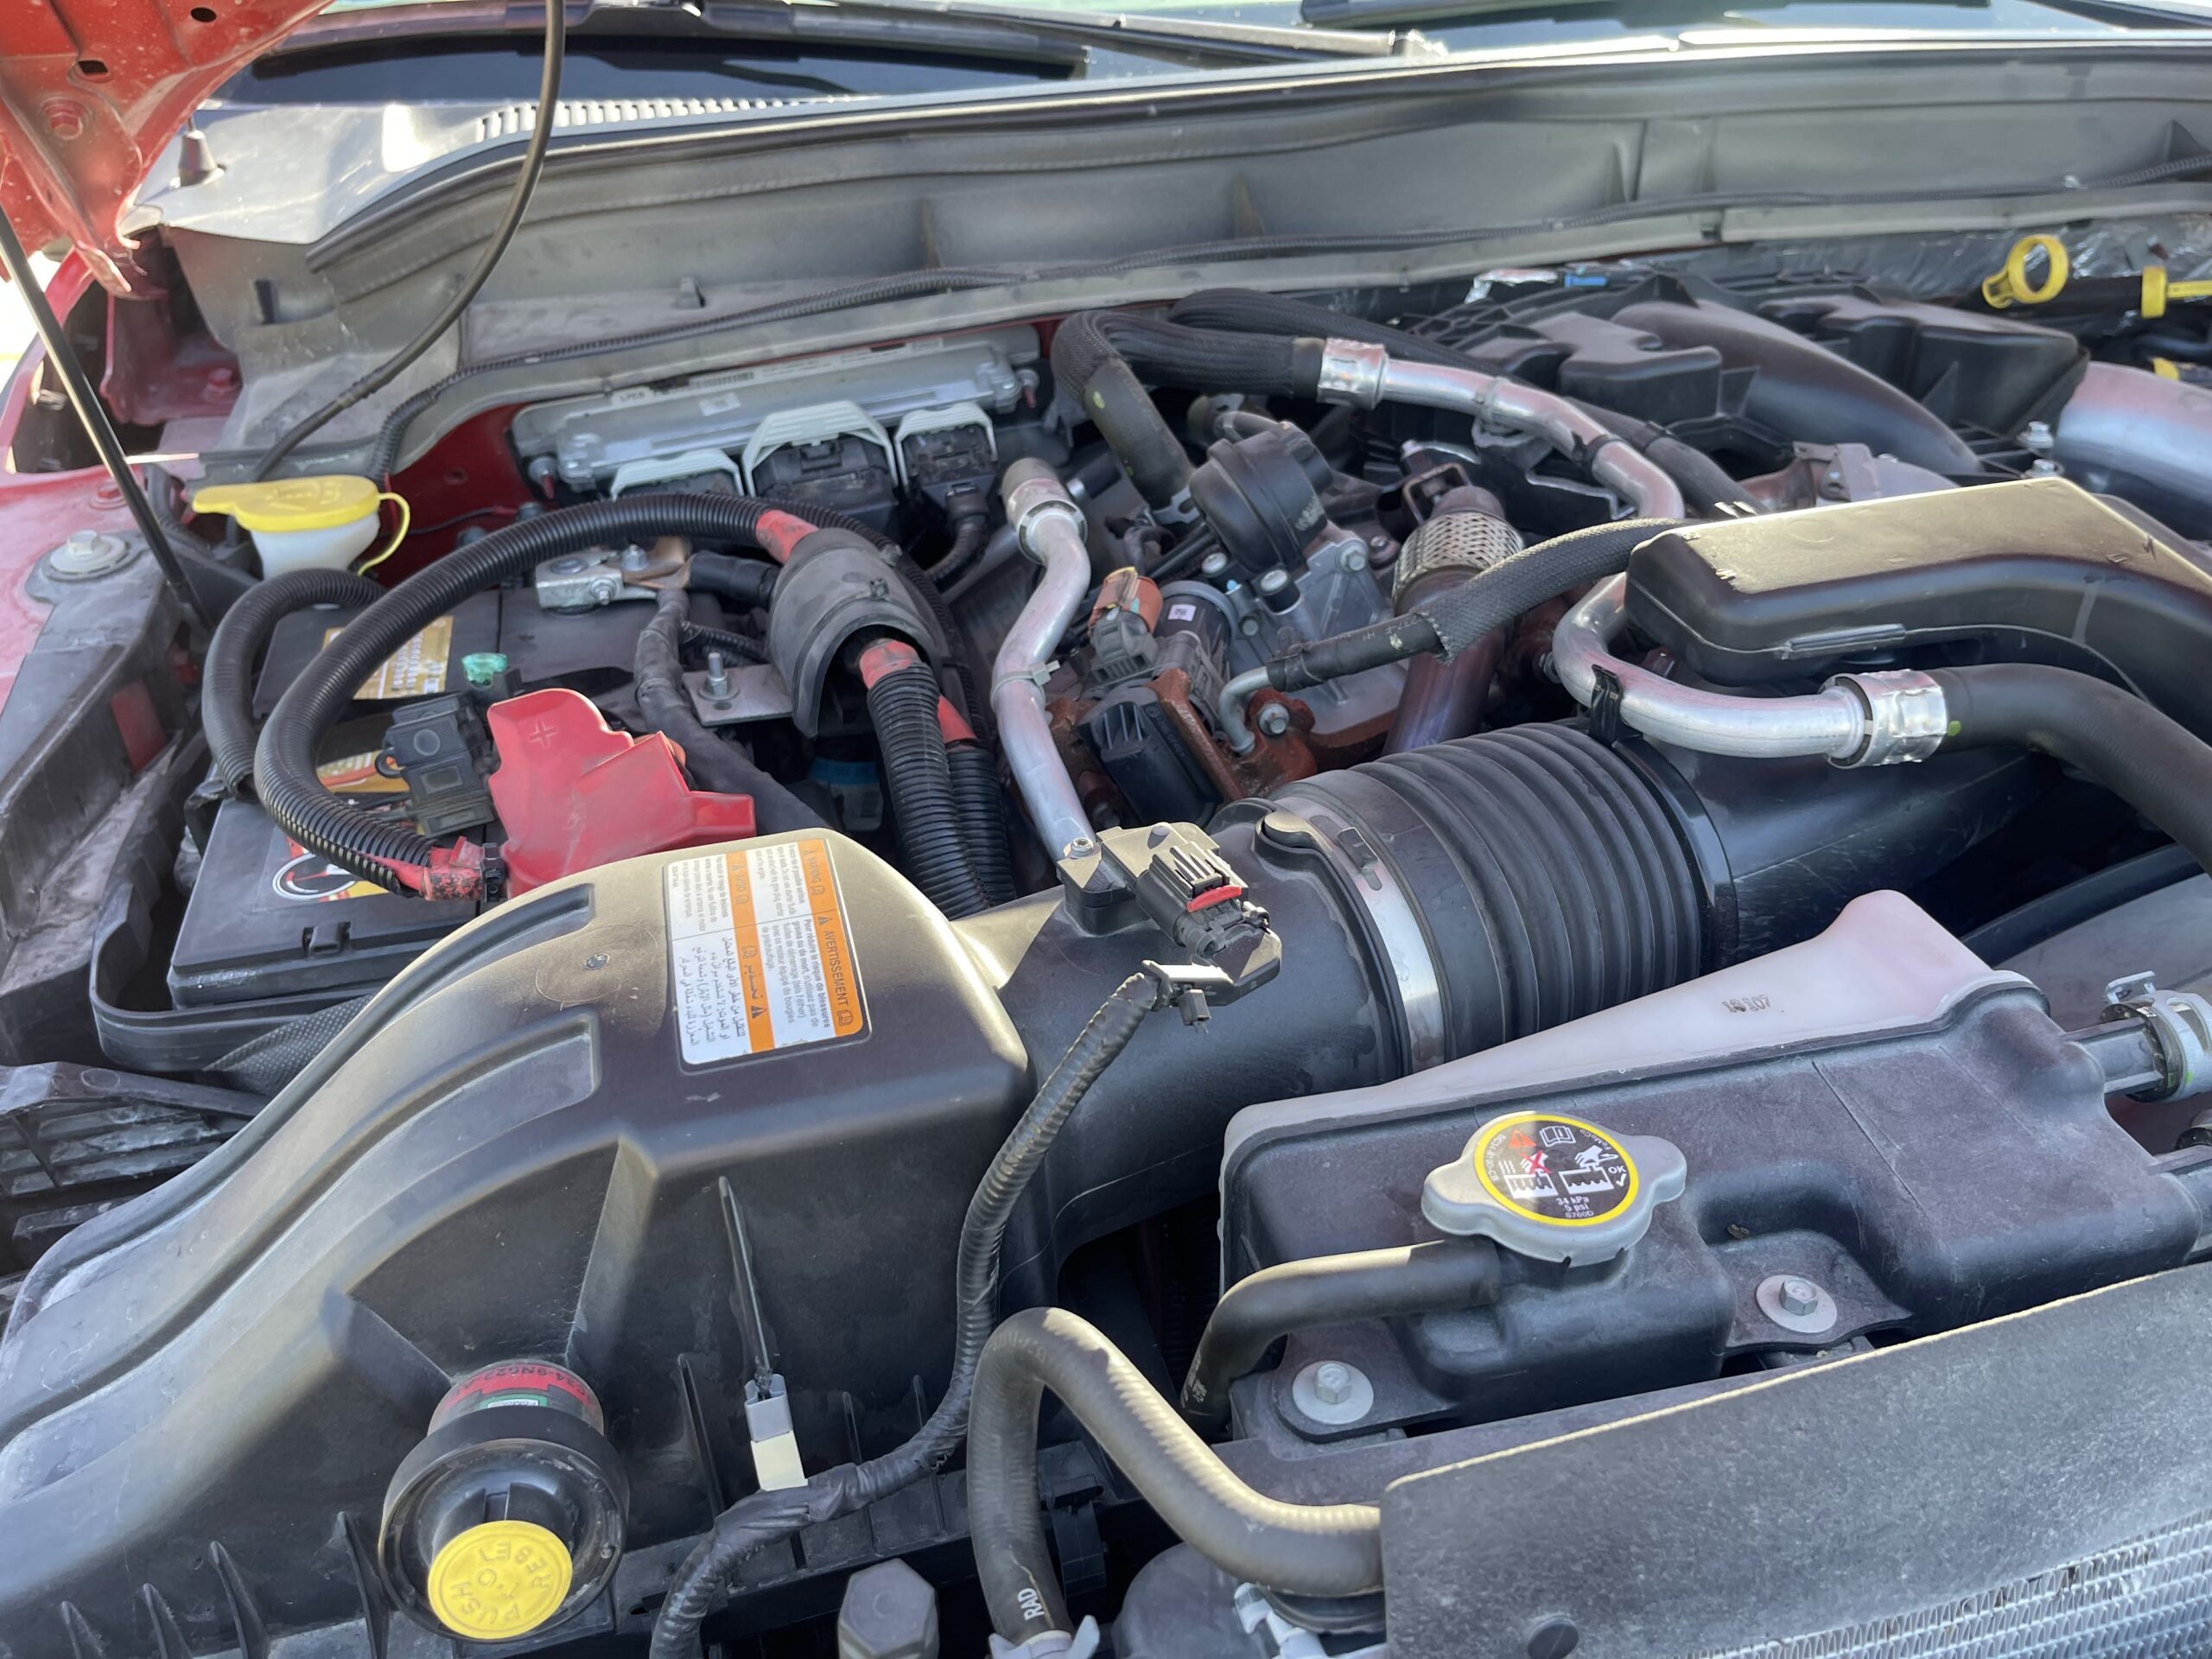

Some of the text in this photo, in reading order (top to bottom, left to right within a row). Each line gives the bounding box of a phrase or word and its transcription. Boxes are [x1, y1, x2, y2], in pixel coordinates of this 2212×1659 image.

[798, 948, 806, 957] de
[810, 961, 822, 982] risque
[823, 930, 849, 1007] AVERTISSEMENT
[783, 987, 791, 995] de
[817, 982, 823, 991] de
[782, 996, 795, 1024] bougies
[807, 1003, 817, 1017] pas
[817, 992, 830, 1027] blessures
[810, 1017, 819, 1027] de
[1580, 1128, 1612, 1151] FoMoCo
[1608, 1165, 1627, 1174] OK
[1556, 1195, 1590, 1206] 34 kPa
[1573, 1203, 1589, 1213] psi
[480, 1541, 552, 1590] RESET
[451, 1581, 521, 1625] PUSH
[1017, 1587, 1045, 1621] RAD
